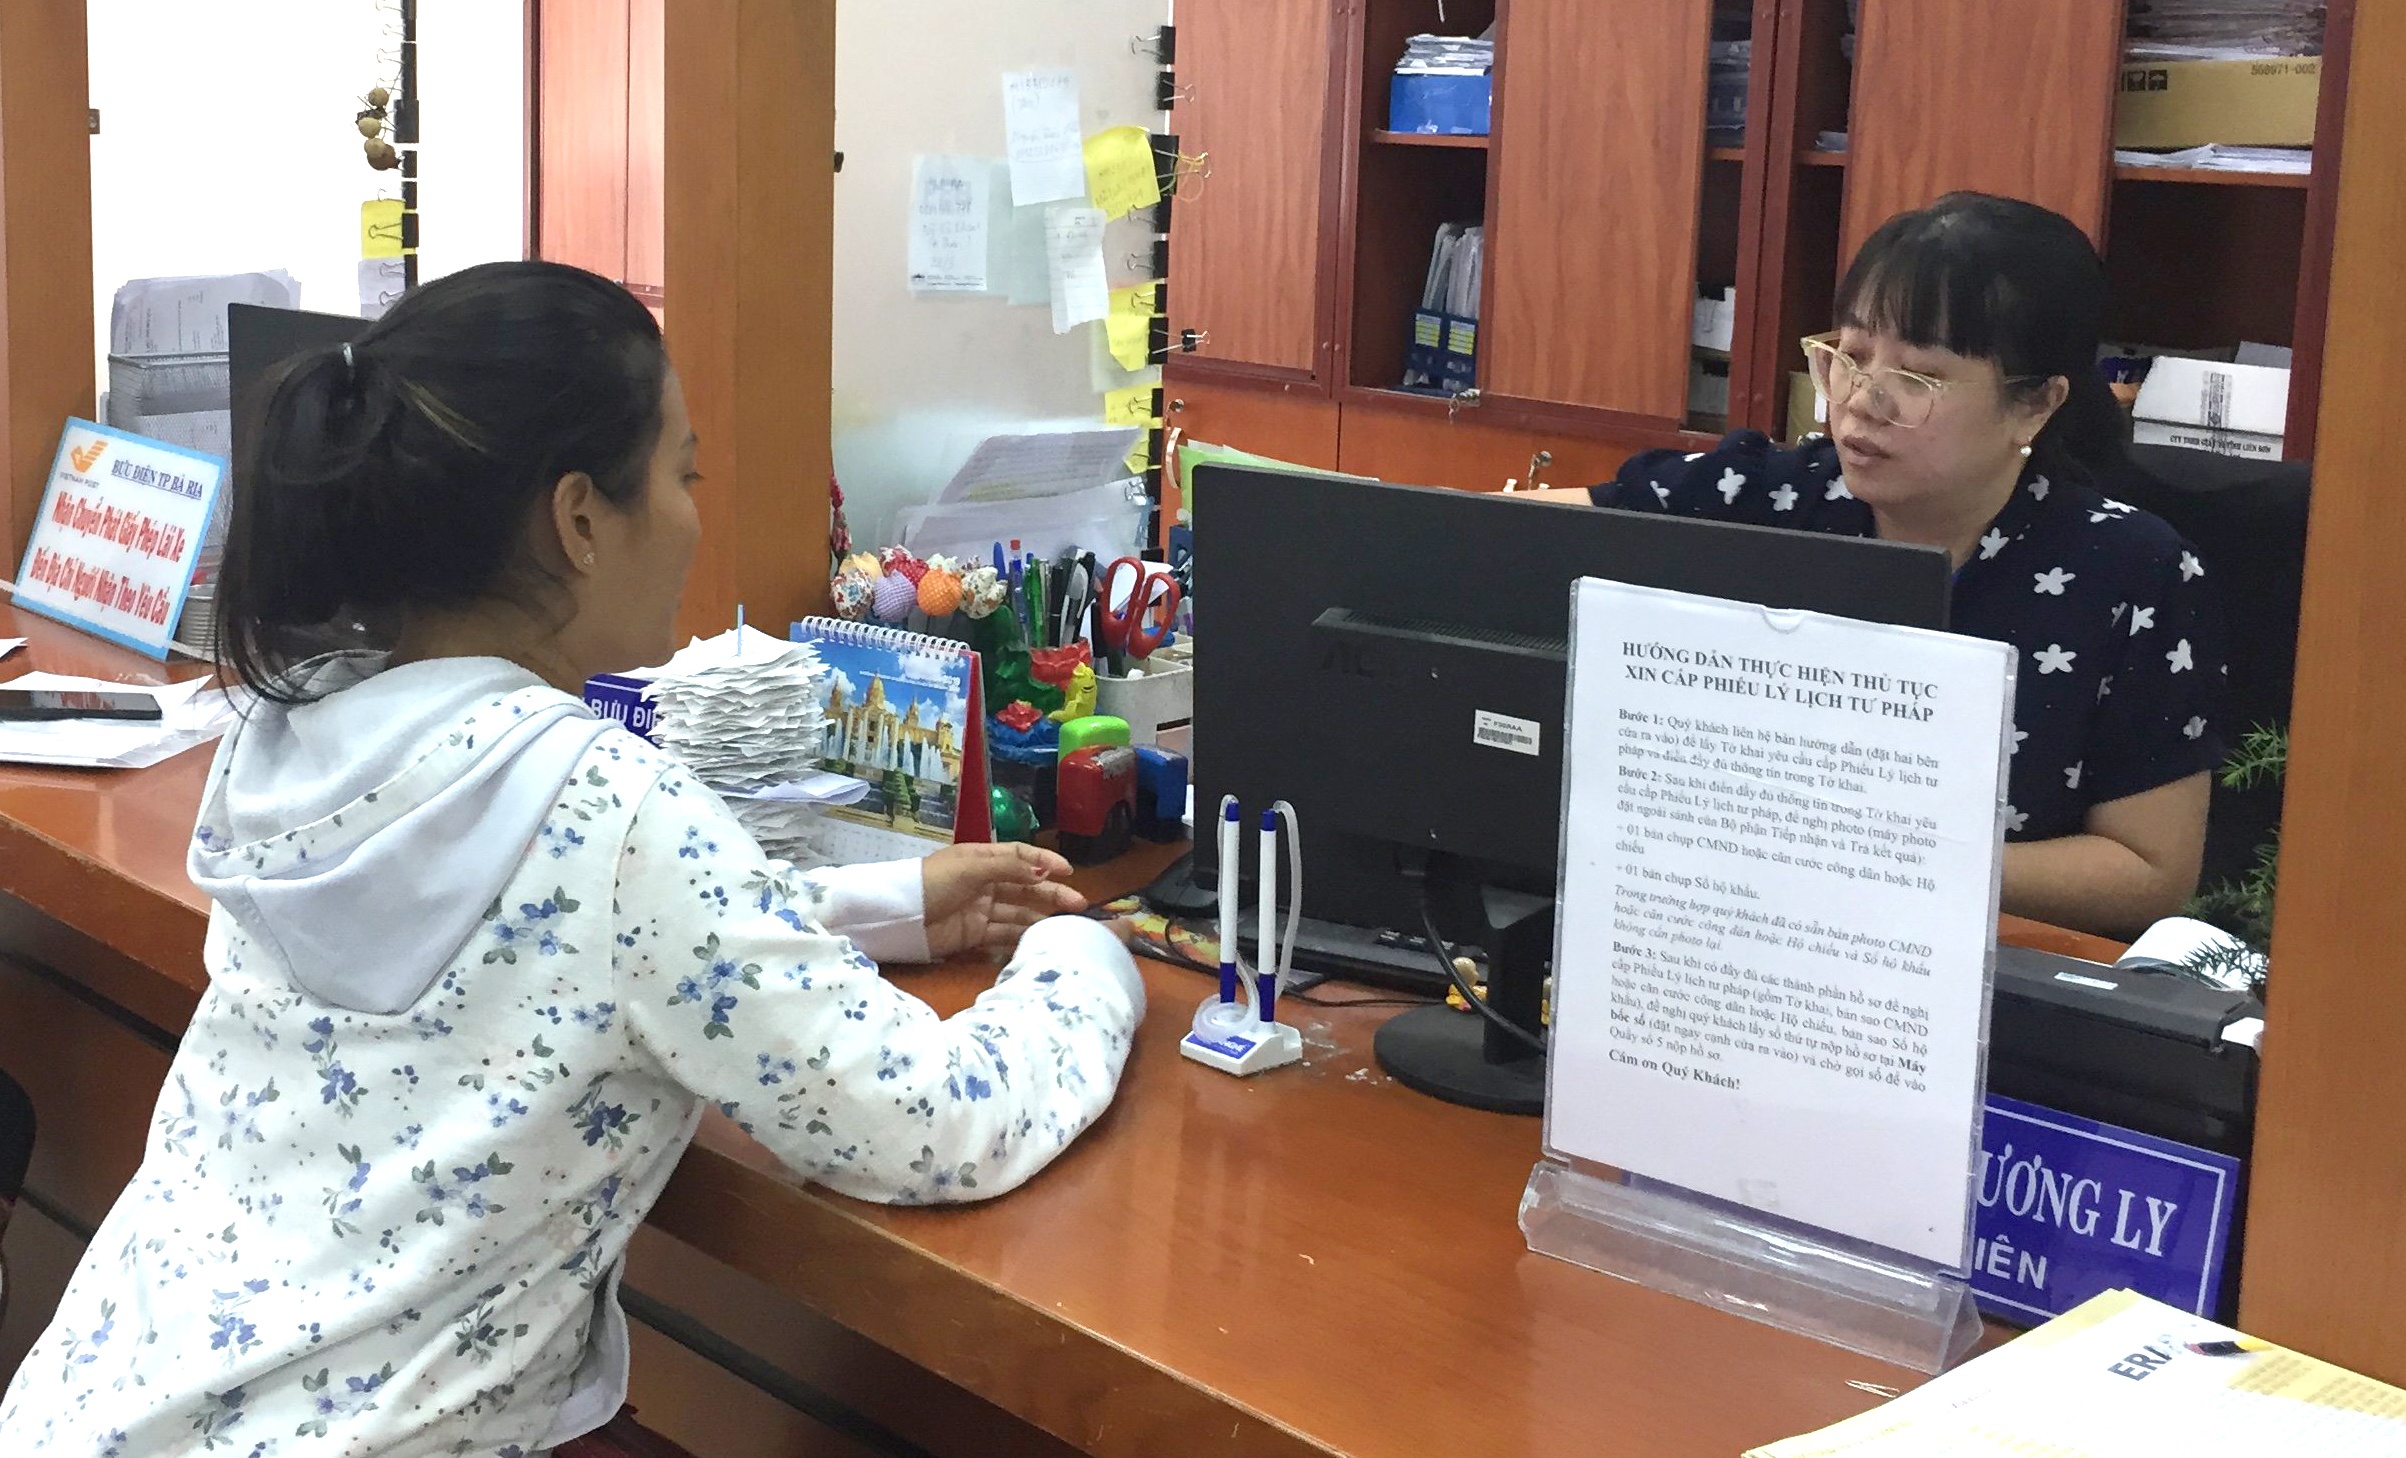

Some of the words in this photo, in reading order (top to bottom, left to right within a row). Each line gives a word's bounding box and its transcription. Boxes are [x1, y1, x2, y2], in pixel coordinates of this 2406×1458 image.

[158, 472, 171, 487] TP
[169, 527, 185, 563] Xe
[1622, 641, 1692, 665] HƯỚNG
[1693, 649, 1734, 671] DẪN
[1737, 656, 1794, 680] THỰC
[1796, 664, 1847, 688] HIỆN
[1849, 671, 1892, 694] THỦ
[1896, 678, 1939, 702] TỤC
[1624, 662, 1659, 683] XIN
[1660, 667, 1699, 688] CẤP
[1702, 674, 1761, 697] PHIẾU
[1764, 682, 1792, 703] LÝ
[1794, 687, 1844, 710] LỊCH
[1846, 694, 1879, 715] TƯ
[1880, 699, 1934, 723] PHÁP
[1638, 731, 1653, 741] ra
[1739, 742, 1765, 759] khai
[1652, 713, 1665, 727] 1:
[1893, 750, 1913, 766] hai
[1765, 766, 1782, 780] tin
[1784, 770, 1816, 789] trong
[1650, 770, 1664, 783] 2:
[1663, 772, 1686, 788] Sau
[1687, 776, 1707, 791] khi
[1812, 797, 1830, 812] tin
[1829, 801, 1865, 821] trong
[1885, 809, 1912, 828] khai
[1696, 835, 1739, 854] CMND
[1829, 819, 1867, 836] photo
[1900, 830, 1938, 849] photo
[1643, 947, 1658, 962] 3:
[1683, 954, 1702, 971] khi
[1882, 1016, 1929, 1038] CMND
[1656, 1035, 1664, 1048] 5
[1757, 1044, 1771, 1056] ra
[1866, 1033, 1888, 1048] sao
[1608, 1047, 1640, 1068] Cám
[1641, 1058, 1659, 1072] ơn
[1661, 1060, 1691, 1081] Quý
[1692, 1067, 1741, 1091] Khách!
[1896, 1055, 1927, 1076] Máy
[2110, 1187, 2178, 1257] LY
